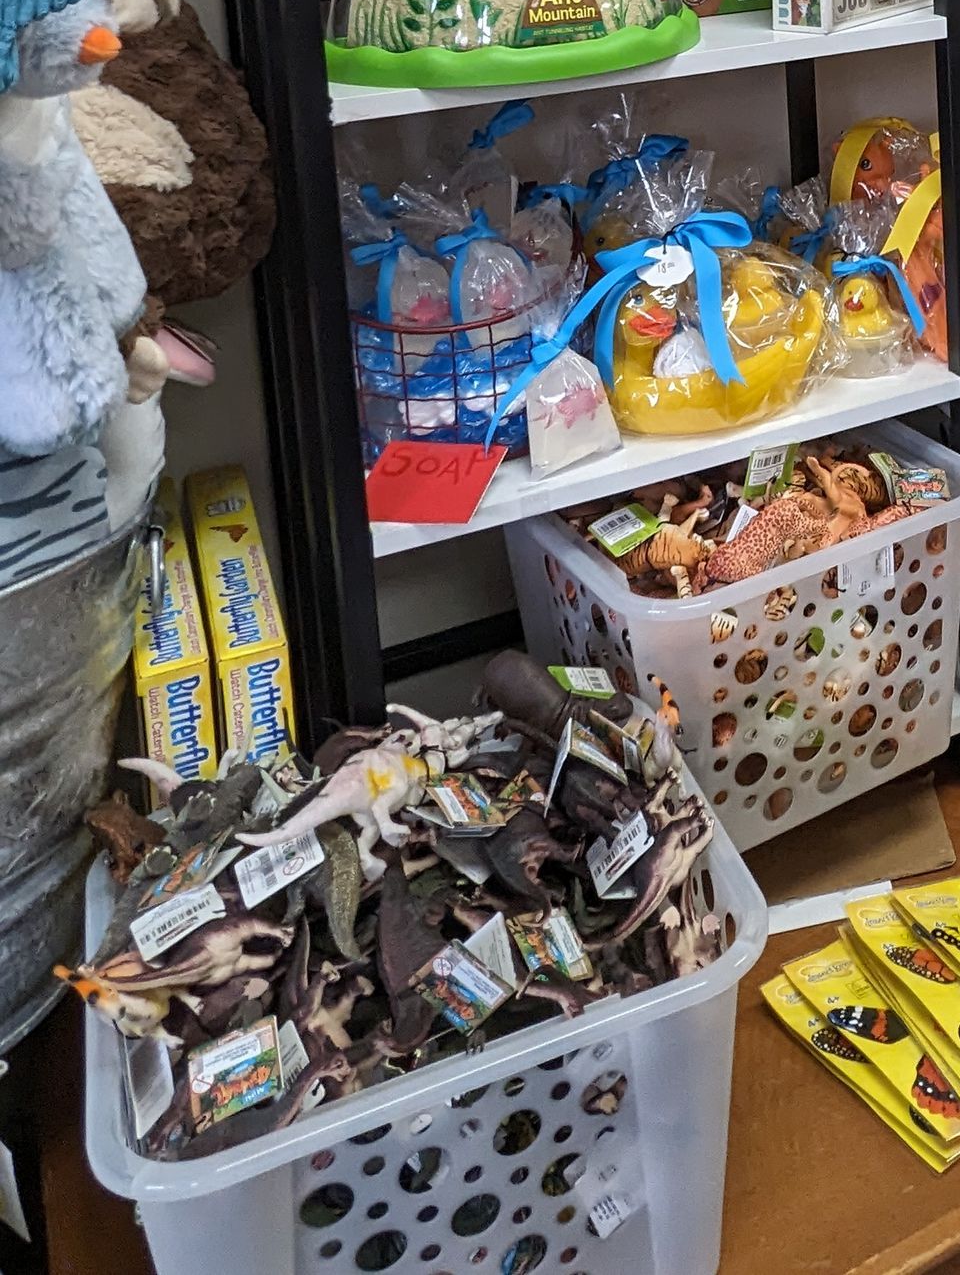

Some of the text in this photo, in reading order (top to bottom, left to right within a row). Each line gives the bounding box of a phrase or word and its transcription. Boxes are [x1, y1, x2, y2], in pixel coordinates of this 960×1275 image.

[528, 5, 596, 24] Mountain
[381, 447, 496, 485] SOAP
[230, 668, 241, 701] Watch
[149, 686, 161, 720] Watch
